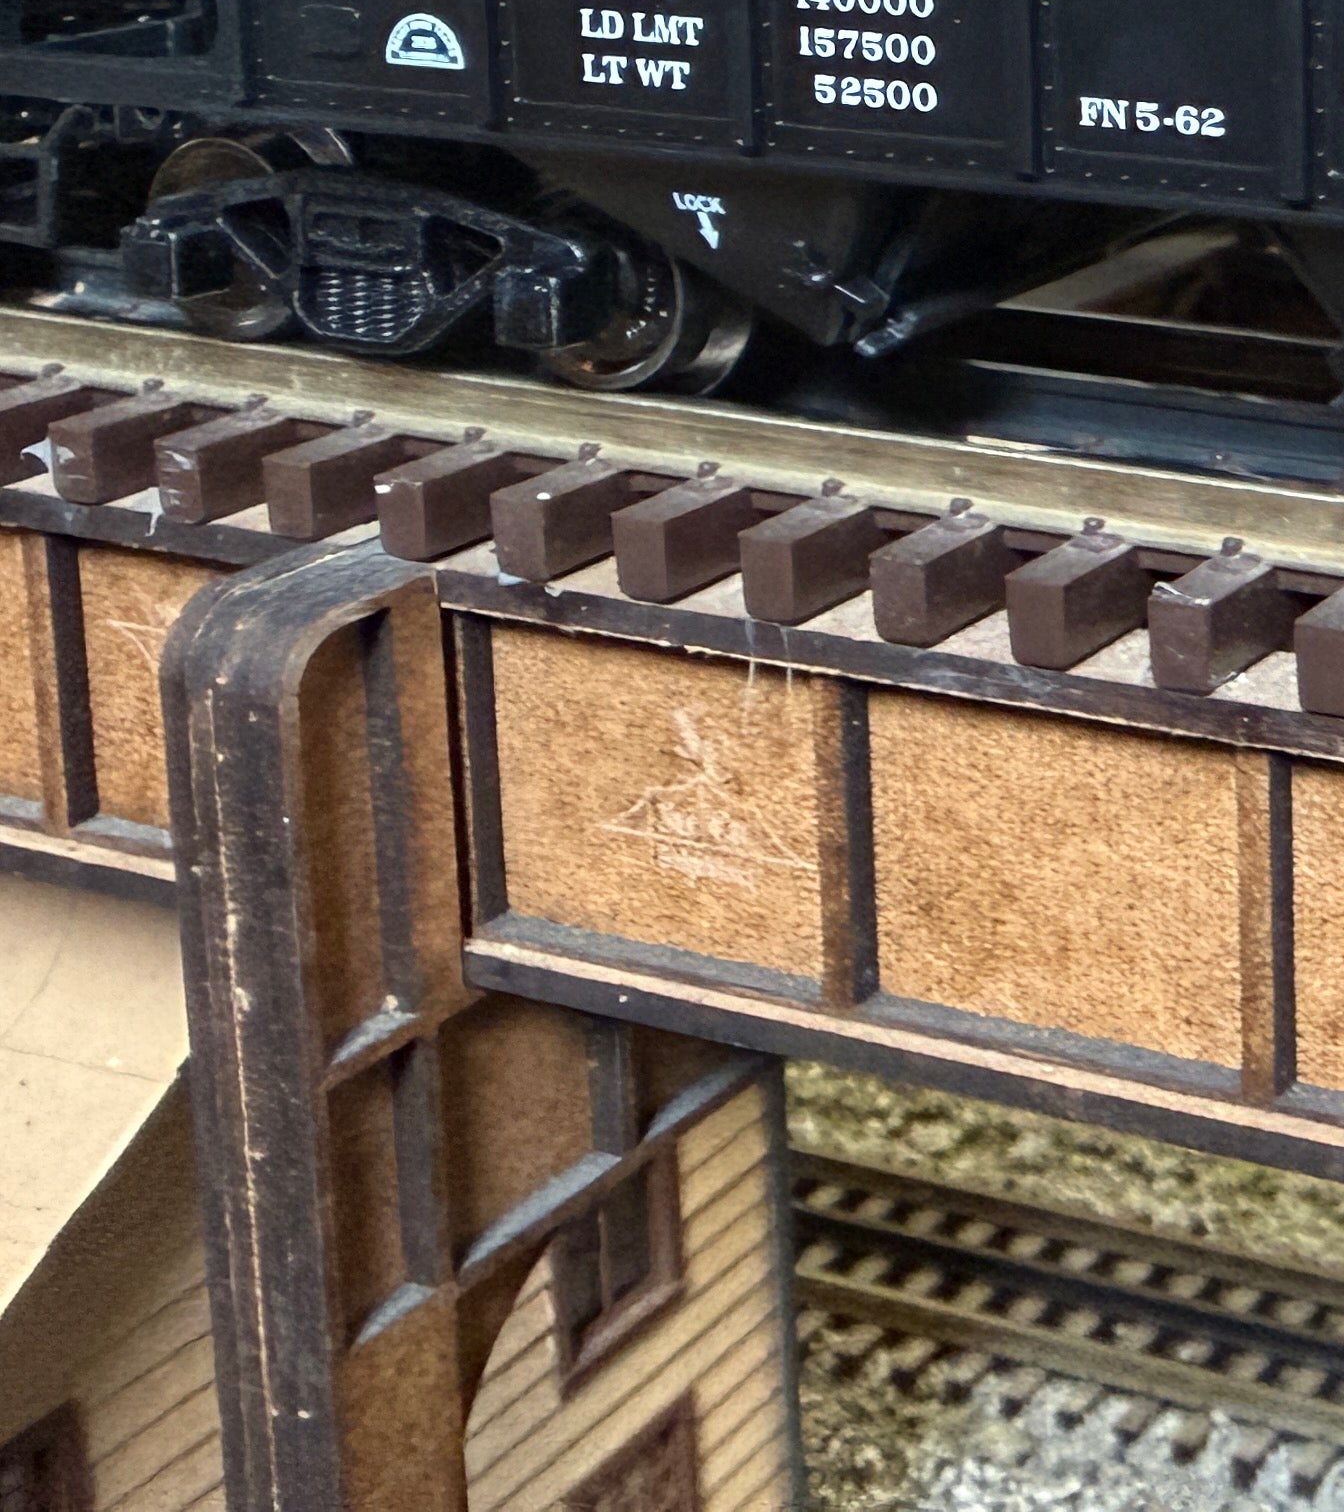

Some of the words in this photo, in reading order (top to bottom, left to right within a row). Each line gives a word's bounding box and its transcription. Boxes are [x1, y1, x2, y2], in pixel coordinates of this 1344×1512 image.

[579, 8, 625, 40] LD
[631, 11, 704, 47] LMT
[799, 25, 936, 66] 157500
[581, 53, 628, 85] LT
[635, 57, 691, 90] WT
[813, 74, 938, 113] 52500
[1079, 96, 1130, 130] FN
[1135, 101, 1226, 137] 5-62
[672, 191, 727, 215] LOCK
